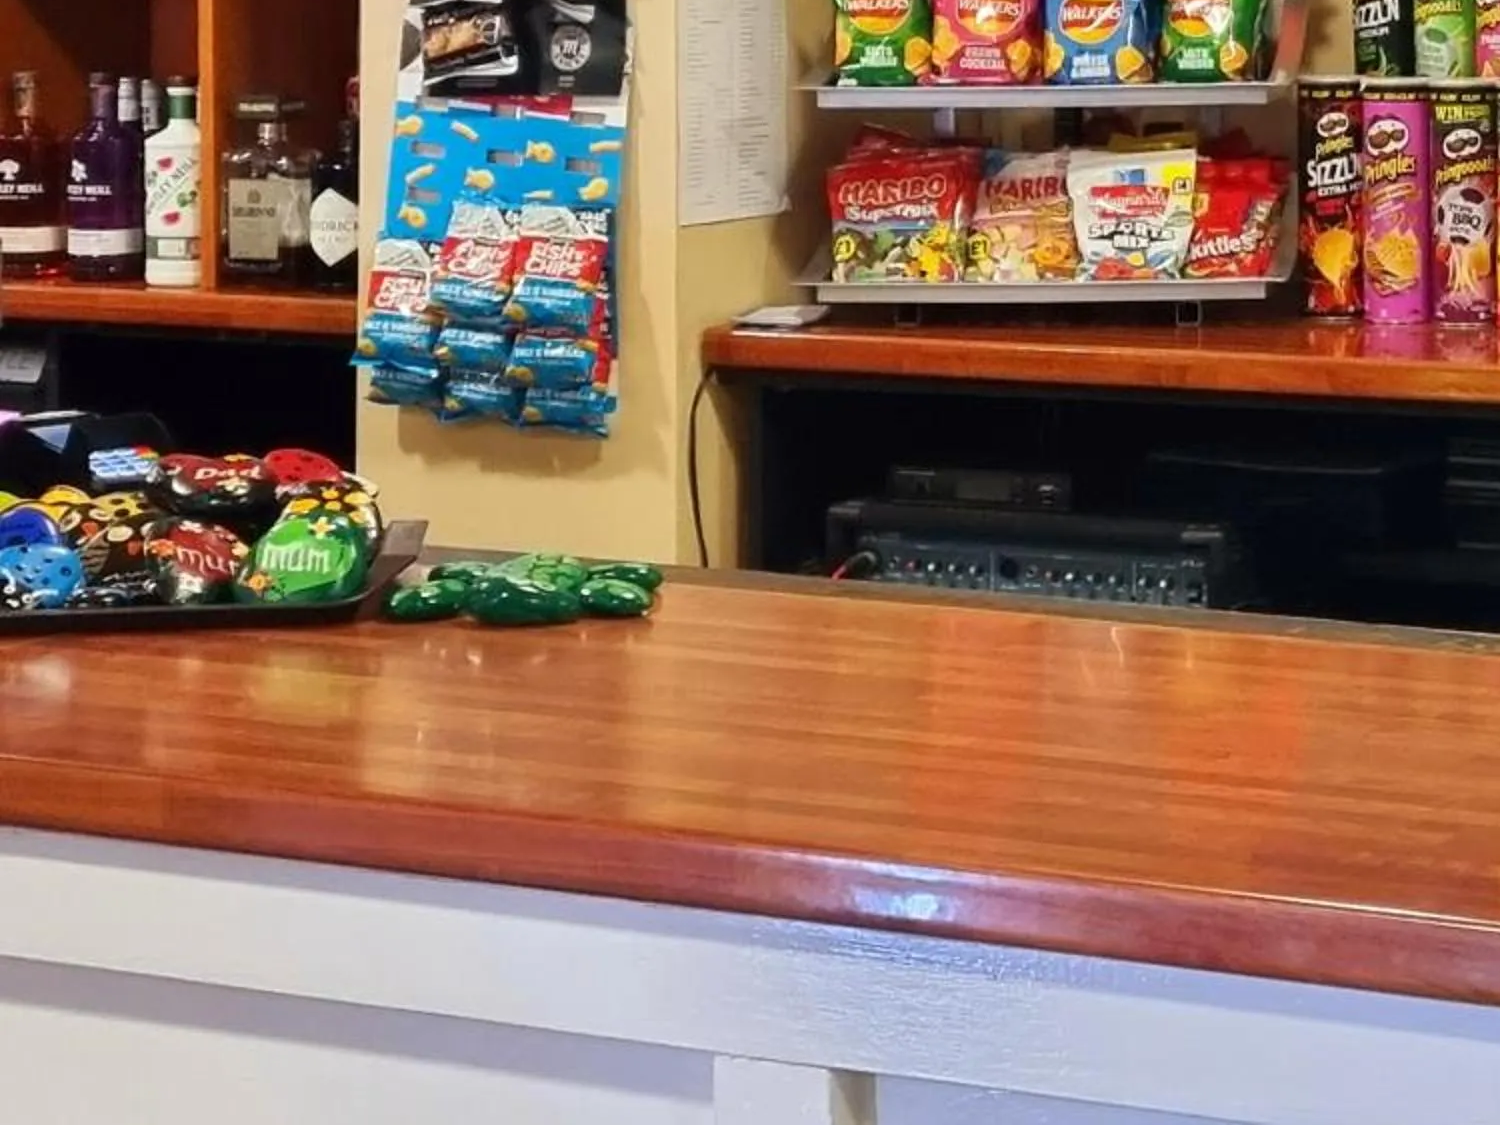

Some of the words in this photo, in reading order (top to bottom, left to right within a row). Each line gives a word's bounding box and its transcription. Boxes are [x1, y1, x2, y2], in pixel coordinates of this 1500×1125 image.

[1364, 153, 1416, 185] Pringles
[839, 174, 947, 205] HARIBO
[1451, 212, 1482, 230] BBQ
[1112, 236, 1151, 250] MIX
[1189, 228, 1266, 260] kittles
[525, 257, 582, 276] CHIPS
